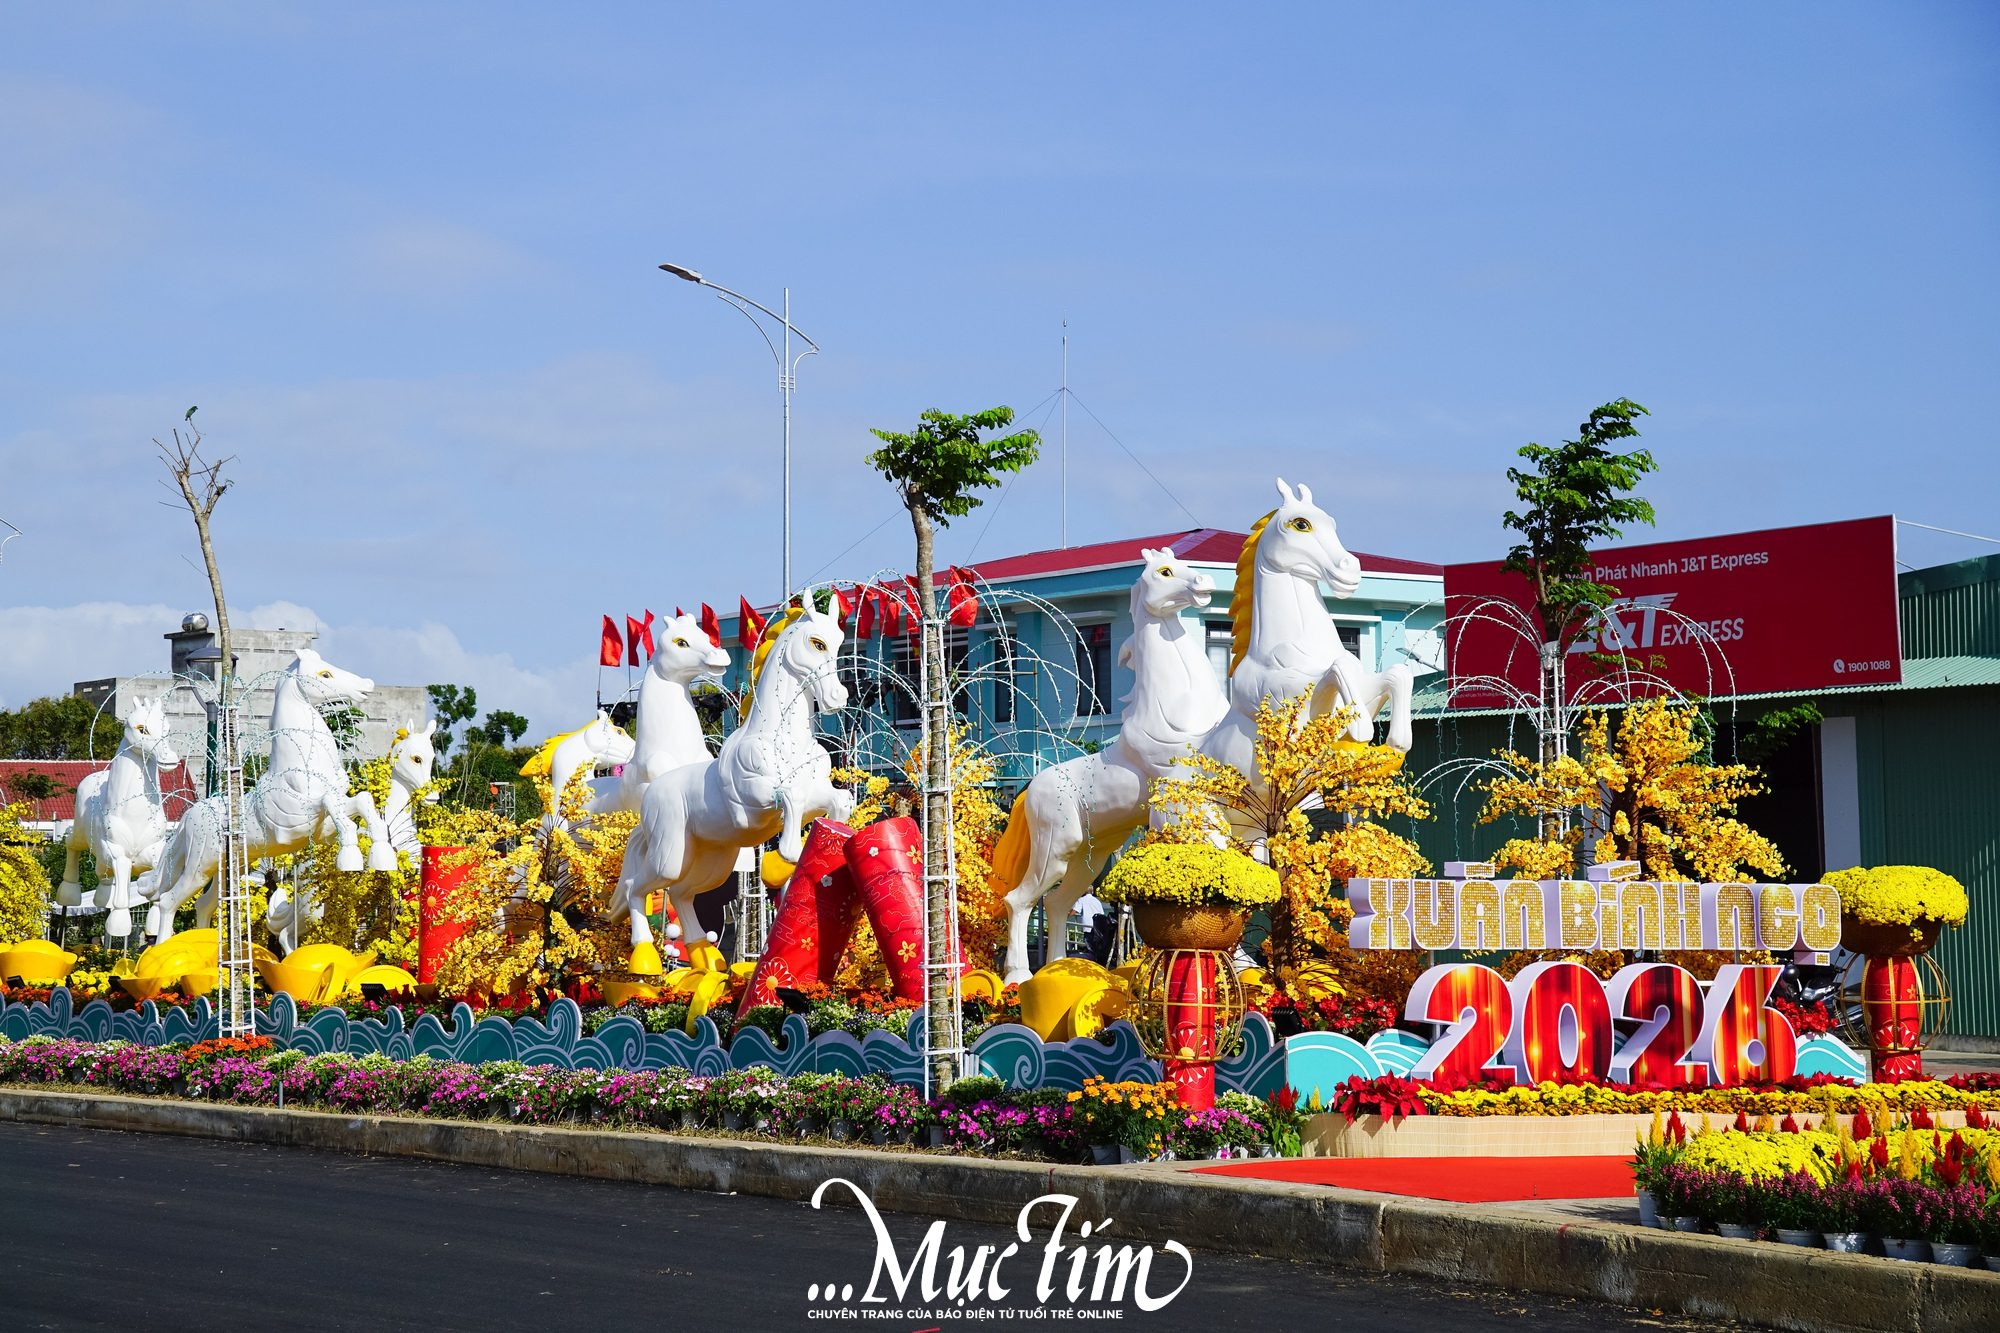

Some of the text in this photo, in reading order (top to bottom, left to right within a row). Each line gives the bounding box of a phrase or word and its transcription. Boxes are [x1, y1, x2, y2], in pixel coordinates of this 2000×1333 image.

[1595, 564, 1628, 581] Phát
[1631, 559, 1677, 578] Nhanh
[1681, 555, 1708, 573] J&T
[1711, 551, 1769, 570] Express
[1660, 617, 1744, 646] EXPRESS
[1848, 660, 1891, 672] 1900 1088
[1405, 962, 1798, 1086] 2026
